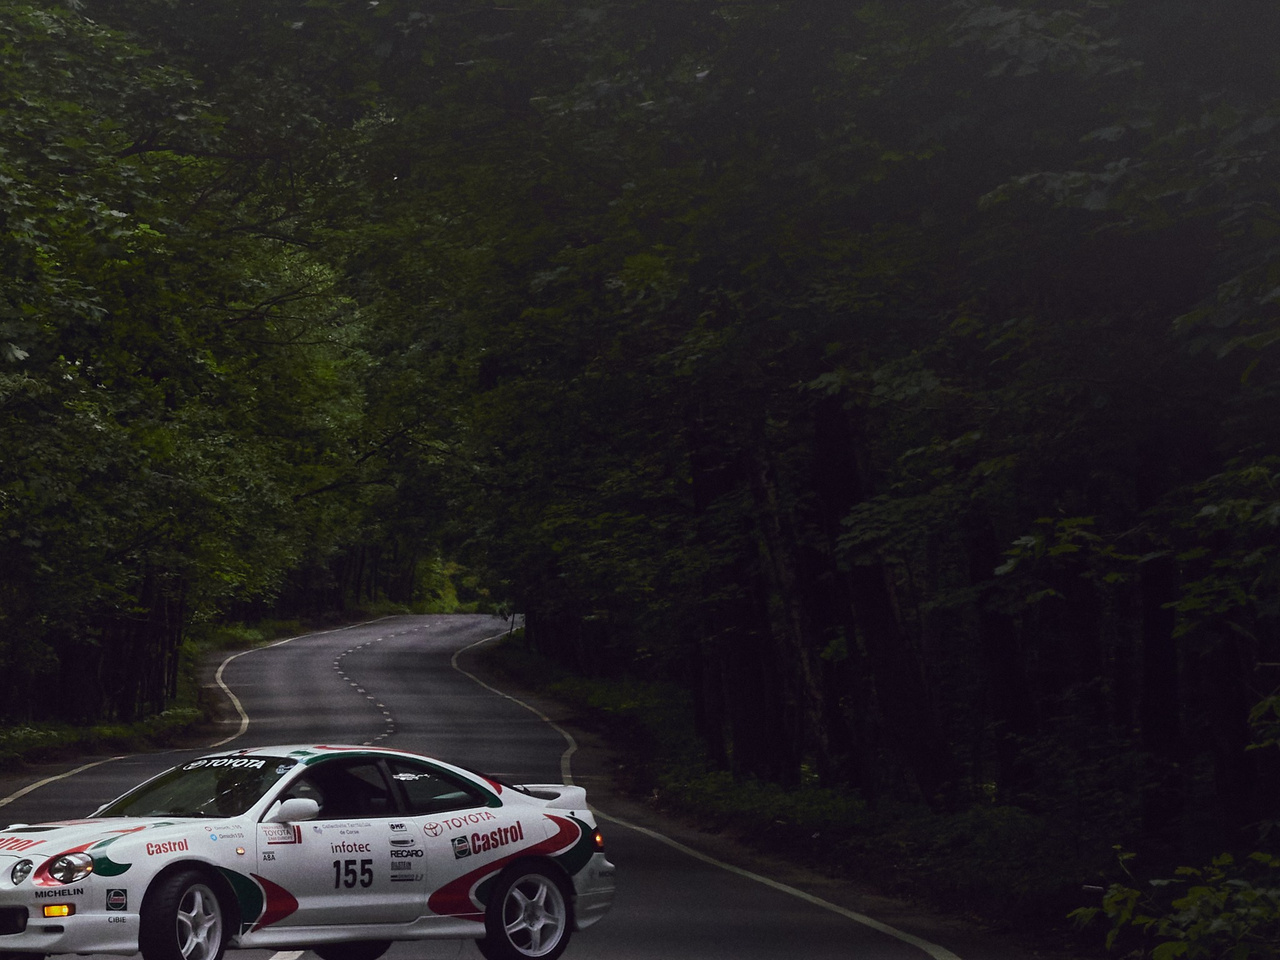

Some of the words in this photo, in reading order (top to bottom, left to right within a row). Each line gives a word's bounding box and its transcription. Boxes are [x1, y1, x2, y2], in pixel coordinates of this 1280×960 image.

[205, 759, 266, 769] TOYOTA
[442, 811, 496, 830] TOYOTA
[471, 820, 524, 855] Castrol
[146, 838, 189, 856] Castrol
[330, 841, 371, 853] infotec
[390, 849, 424, 858] RECARO
[333, 859, 373, 889] 155
[35, 888, 84, 898] MICHELIN
